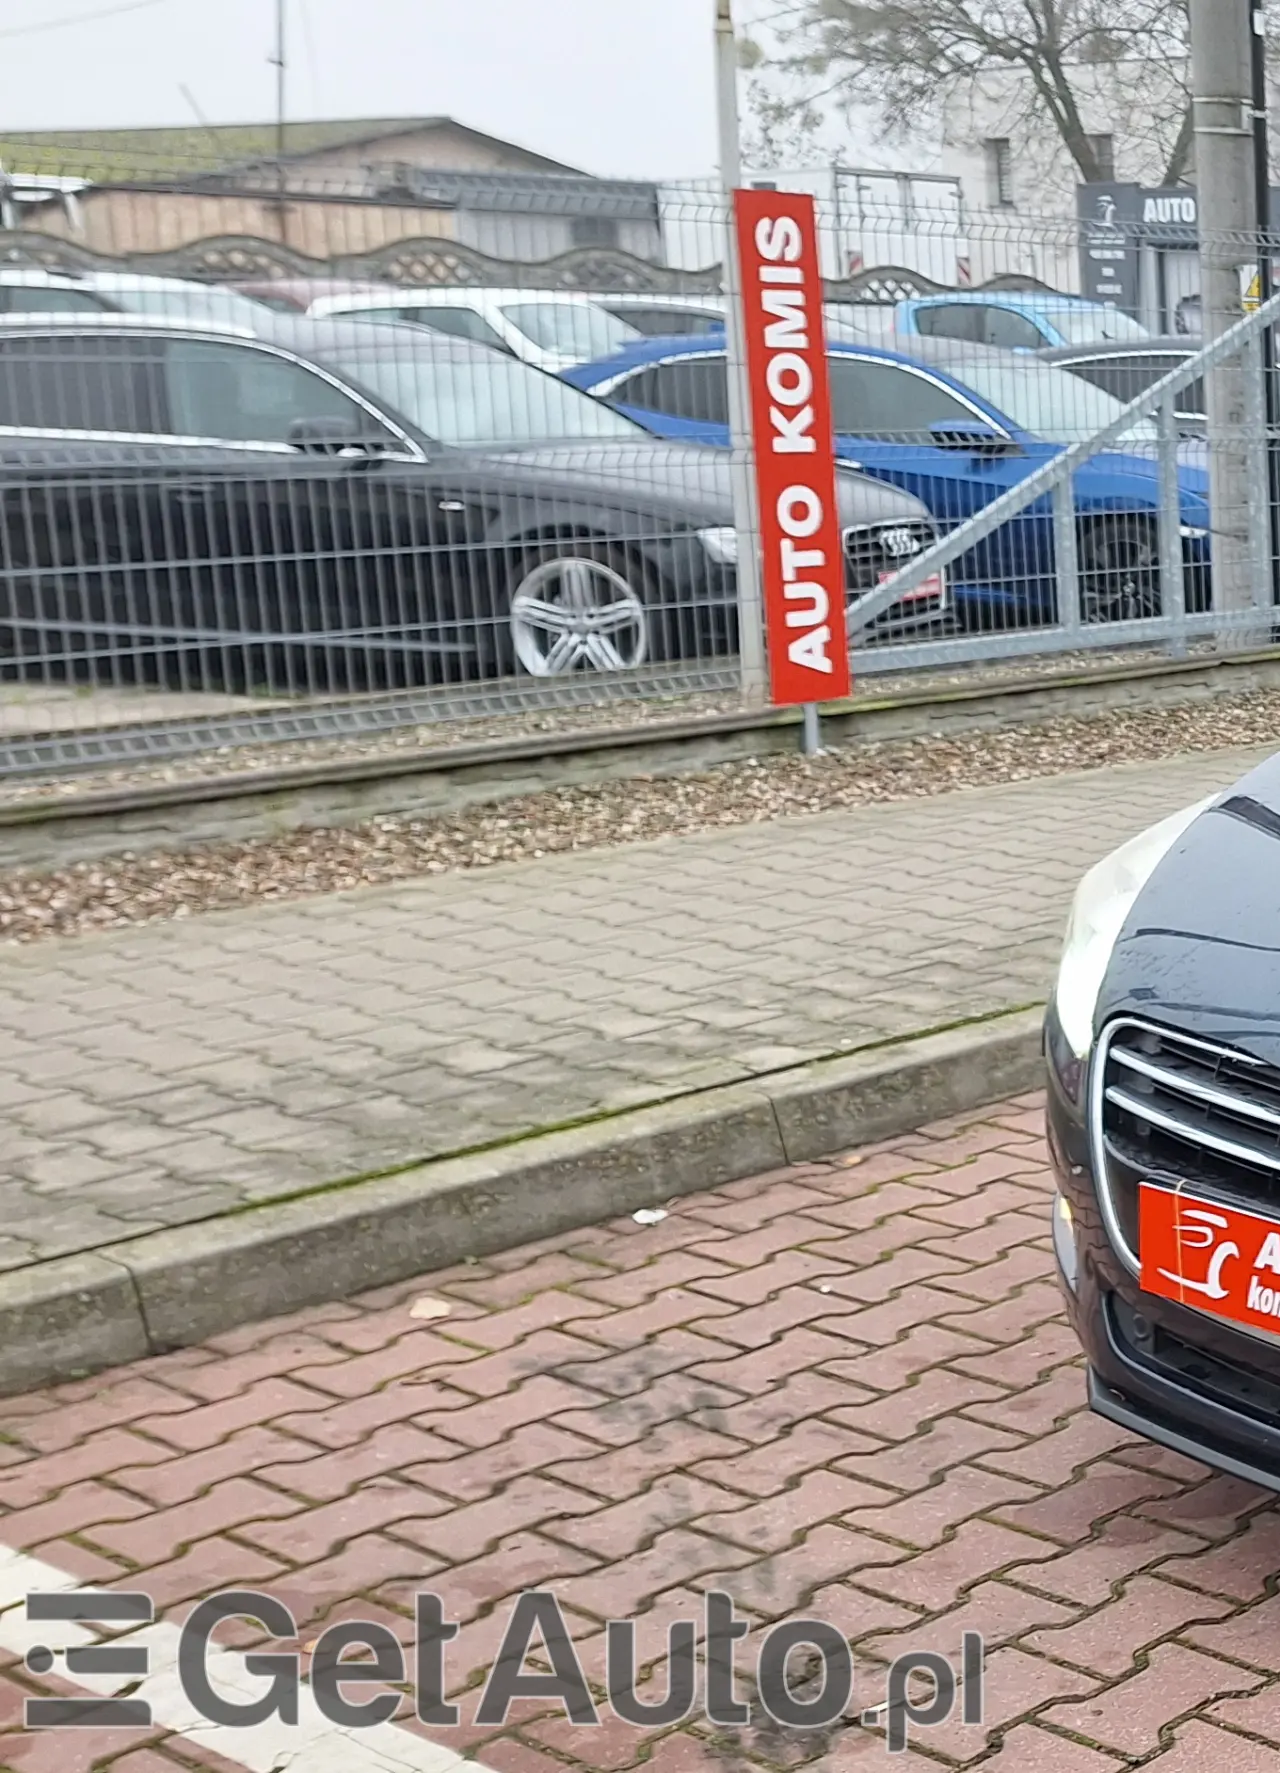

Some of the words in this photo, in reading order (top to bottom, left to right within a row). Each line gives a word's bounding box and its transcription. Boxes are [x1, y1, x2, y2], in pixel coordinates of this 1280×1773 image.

[1143, 197, 1196, 223] AUTO
[755, 216, 814, 452] KOMIS
[777, 485, 832, 673] AUTO
